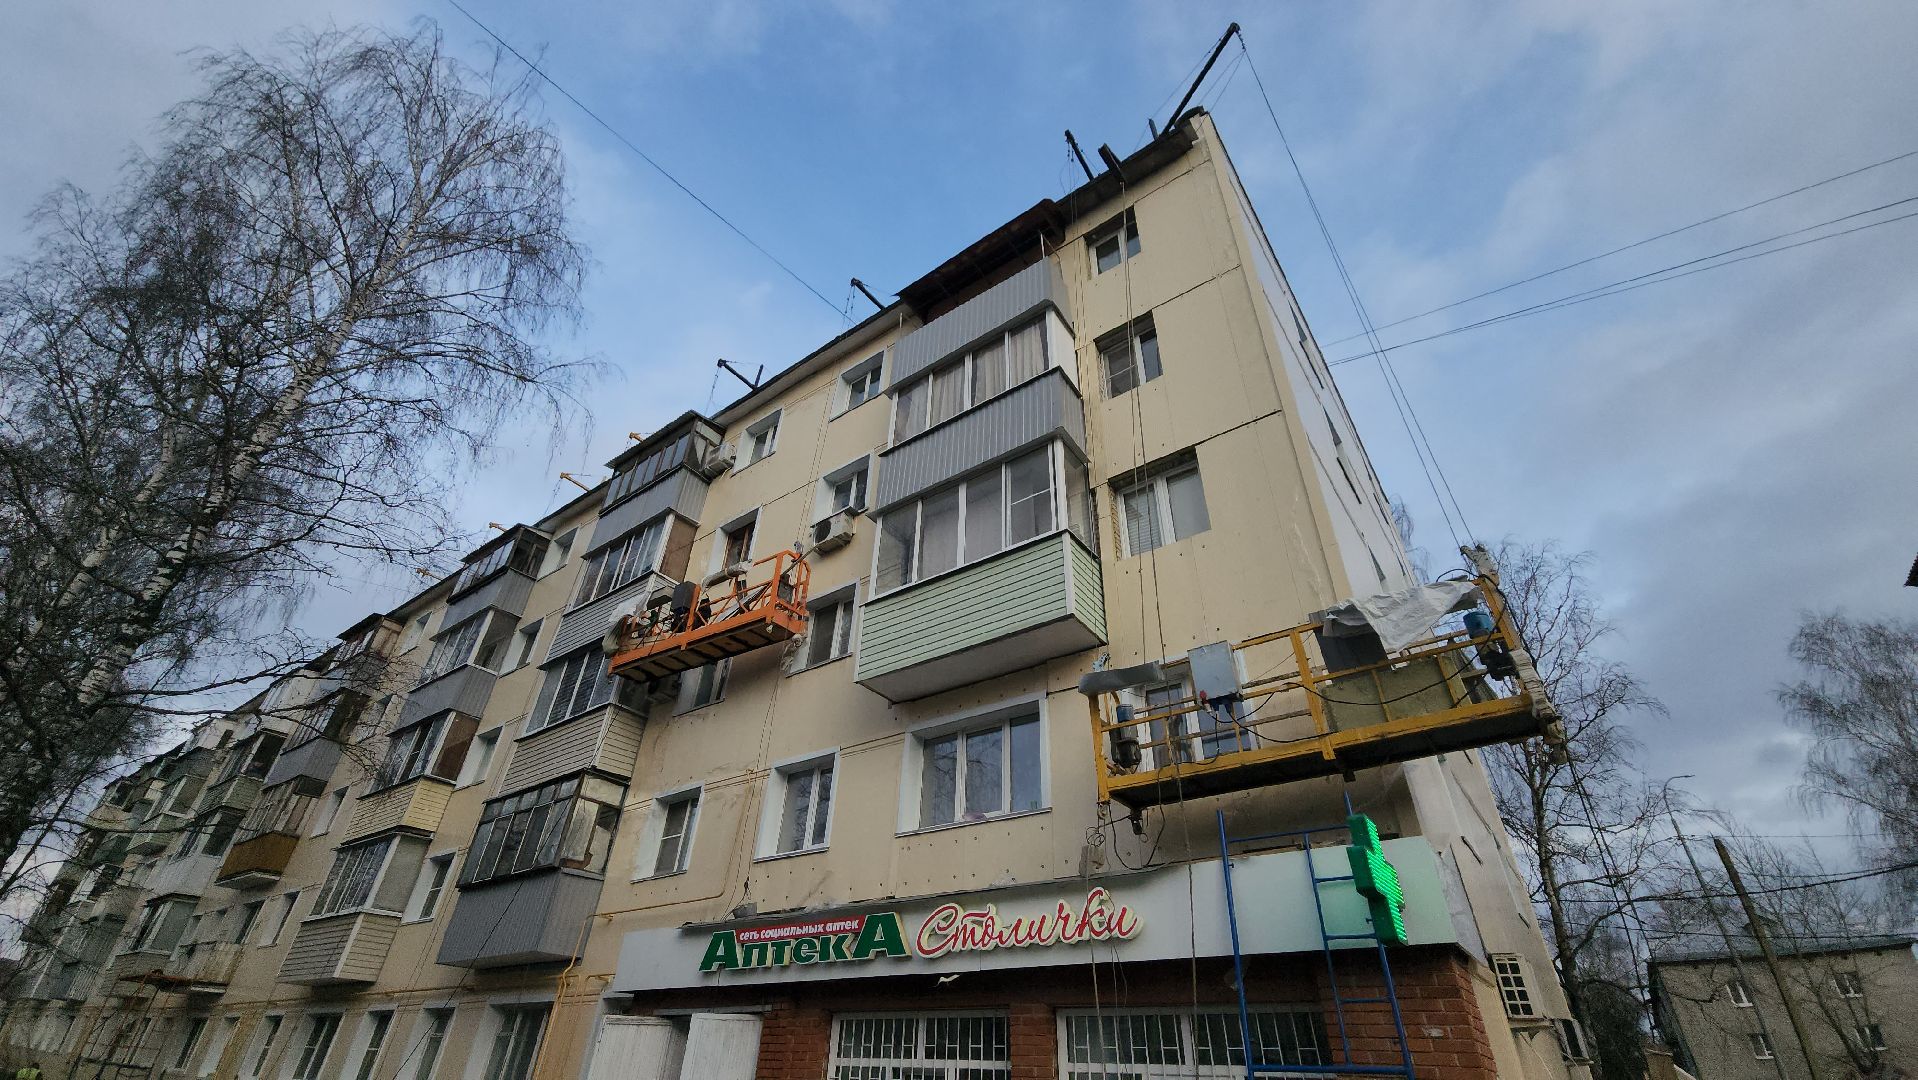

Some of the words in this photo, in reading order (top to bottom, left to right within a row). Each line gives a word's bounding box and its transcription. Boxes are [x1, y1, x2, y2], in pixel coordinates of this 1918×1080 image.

[739, 930, 760, 941] сеть
[760, 923, 824, 940] социальных
[825, 918, 860, 931] аптек
[915, 888, 1141, 957] Столички
